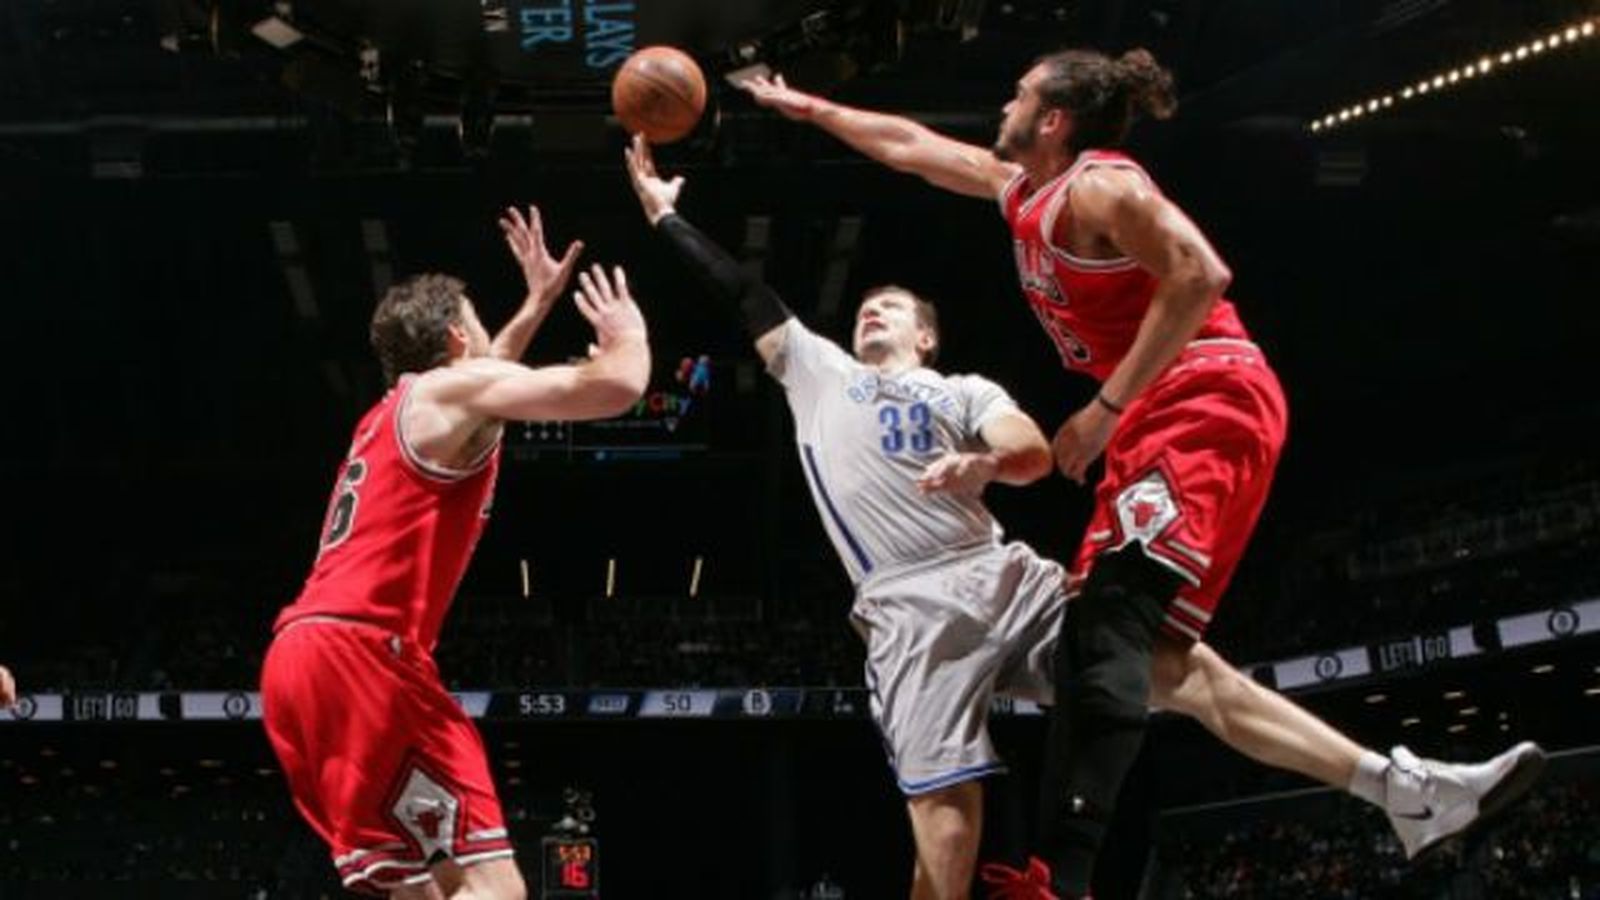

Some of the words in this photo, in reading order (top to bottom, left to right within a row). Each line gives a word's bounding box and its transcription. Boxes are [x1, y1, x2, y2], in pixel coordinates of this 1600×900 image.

[584, 0, 637, 68] LAYS
[879, 402, 934, 453] 33
[519, 693, 565, 714] 5:53
[663, 692, 691, 714] 50
[562, 862, 589, 888] 16
